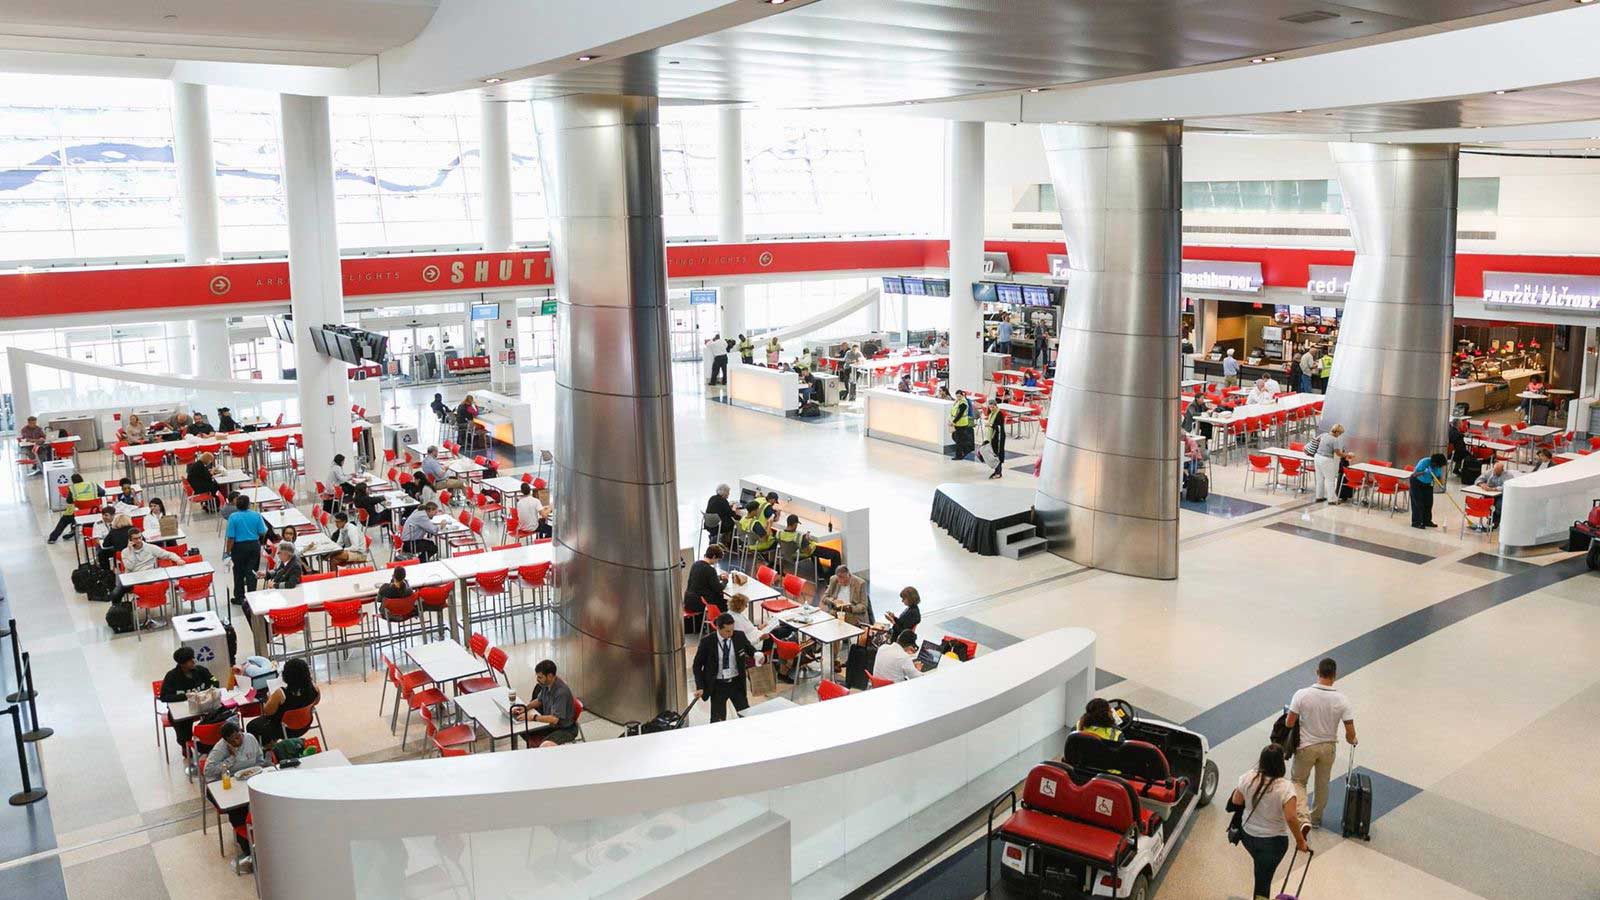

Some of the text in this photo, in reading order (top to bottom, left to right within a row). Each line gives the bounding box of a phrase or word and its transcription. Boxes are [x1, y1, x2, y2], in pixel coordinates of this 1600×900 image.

[341, 272, 400, 281] LIGHTS
[451, 258, 552, 283] SHUTT
[1181, 272, 1252, 289] mashburger
[1307, 277, 1337, 294] red
[1483, 289, 1600, 308] PRETZEL FACTORY
[1514, 284, 1568, 296] PHILLY
